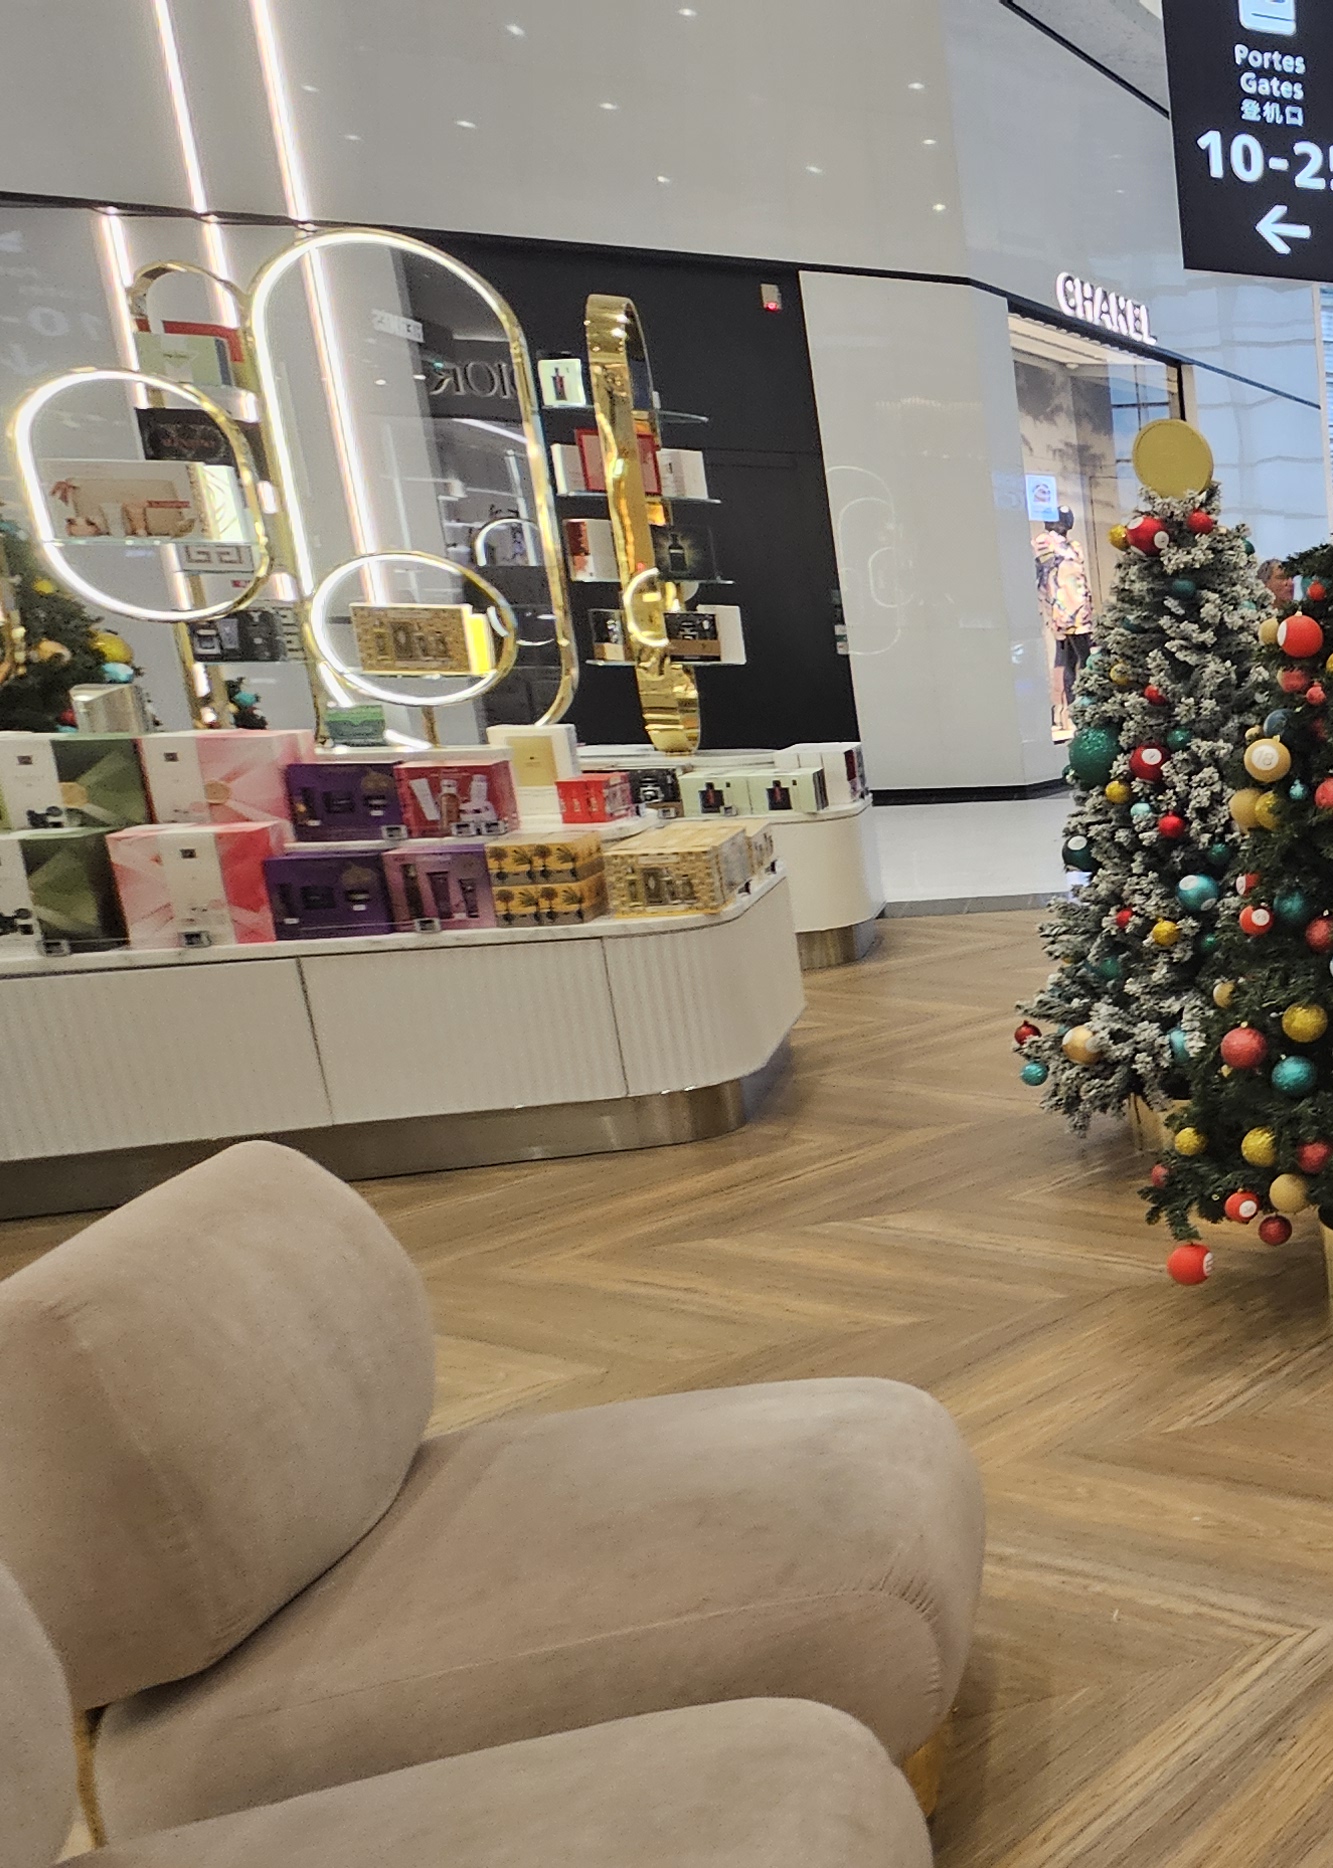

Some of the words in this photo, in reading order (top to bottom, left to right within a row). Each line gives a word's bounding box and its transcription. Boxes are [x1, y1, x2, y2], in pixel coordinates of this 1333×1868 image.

[1234, 43, 1306, 75] Portes
[1240, 72, 1304, 100] Gates
[1240, 99, 1304, 127] 登机口
[1056, 271, 1158, 346] CHANEL
